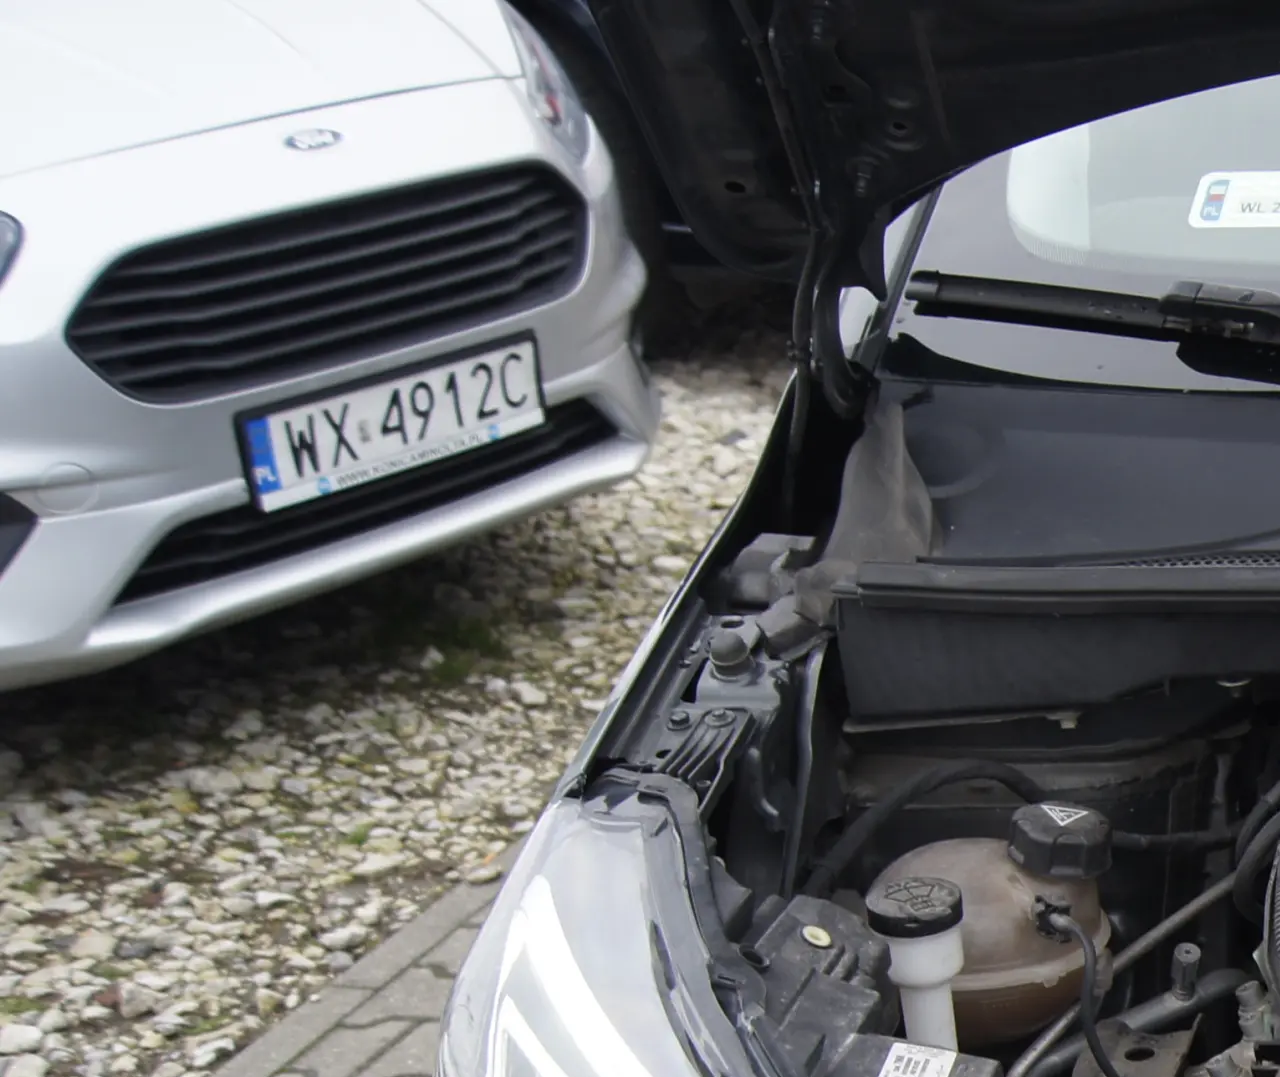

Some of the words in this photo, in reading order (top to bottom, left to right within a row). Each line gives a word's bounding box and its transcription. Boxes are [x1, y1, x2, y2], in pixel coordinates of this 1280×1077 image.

[1240, 203, 1264, 214] WL
[284, 402, 359, 479] WX
[381, 351, 529, 445] 4912C
[253, 466, 277, 485] PL
